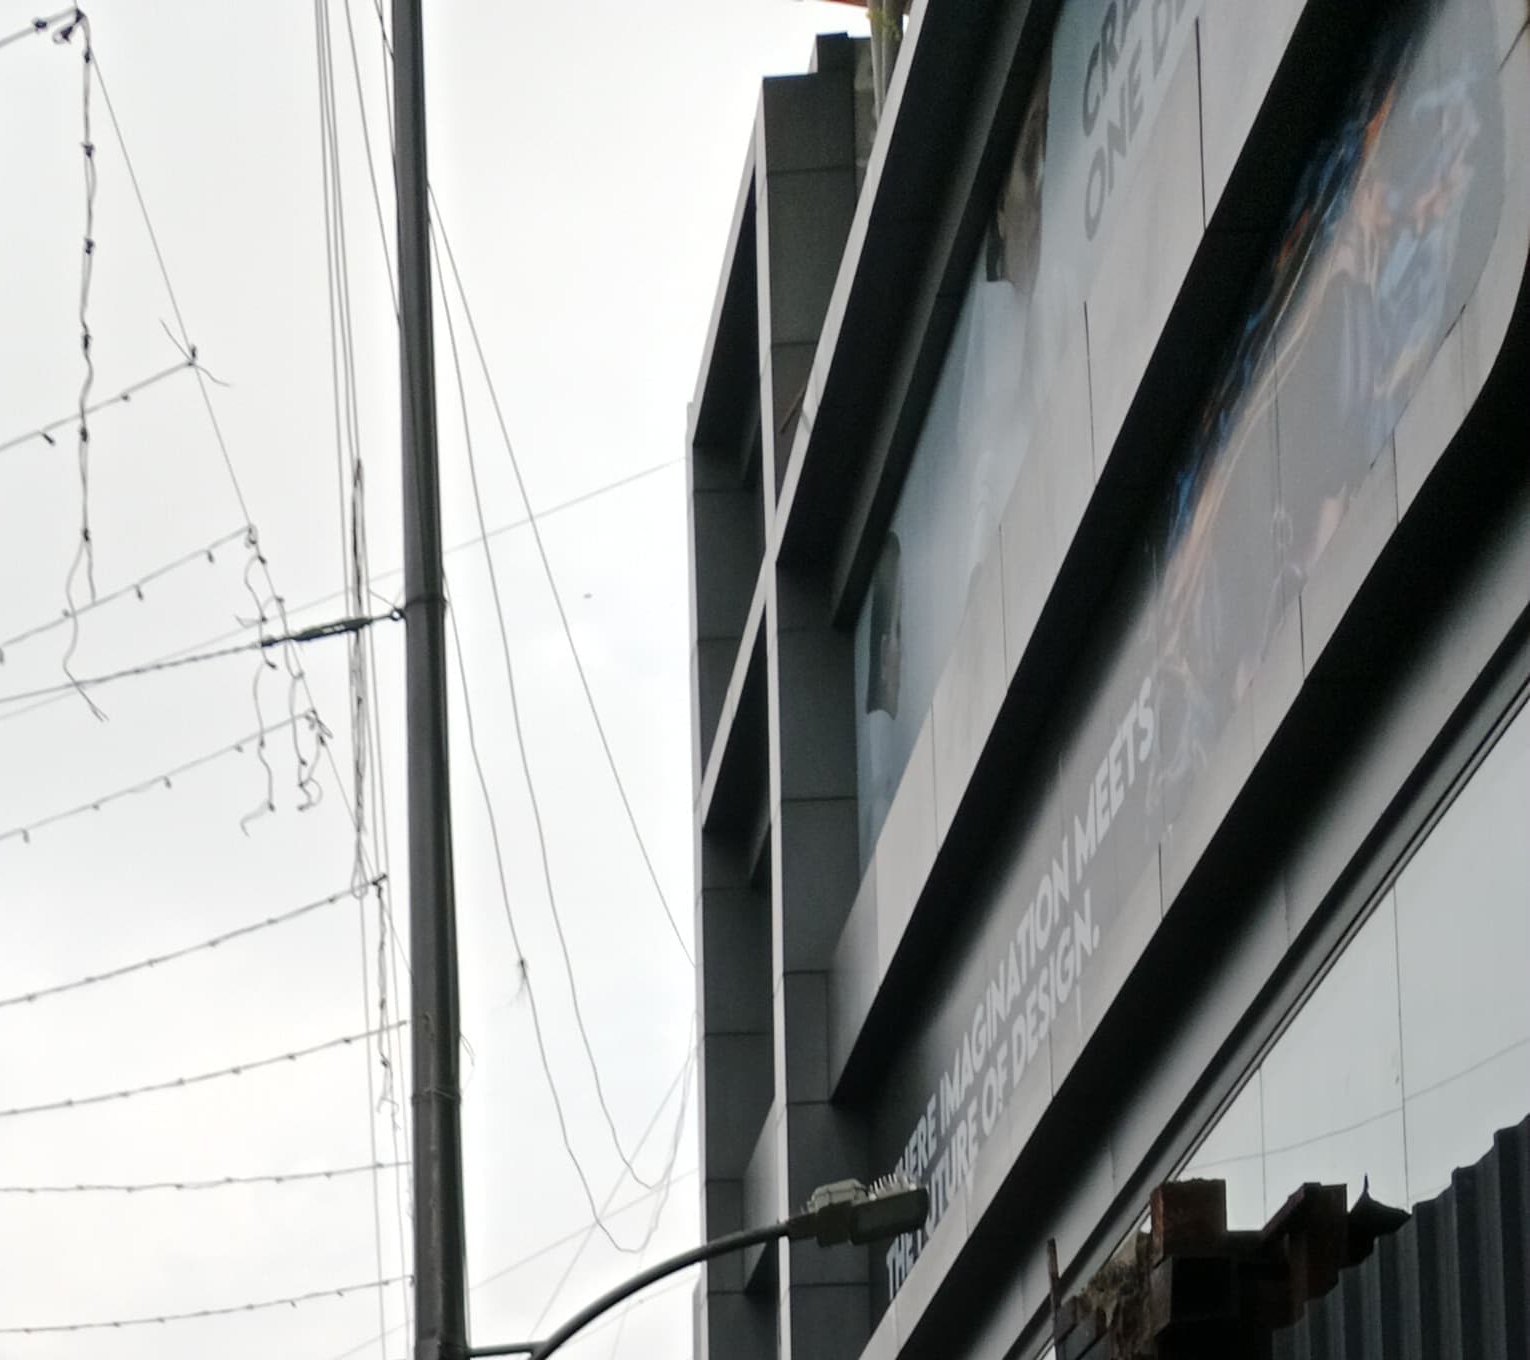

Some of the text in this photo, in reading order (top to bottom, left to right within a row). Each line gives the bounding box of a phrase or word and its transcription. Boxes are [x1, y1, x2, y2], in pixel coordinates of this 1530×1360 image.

[1085, 39, 1144, 241] ONE
[886, 1231, 914, 1301] THE
[982, 1041, 1007, 1136] OF
[1012, 888, 1100, 1088] DESIGN.
[940, 835, 1069, 1136] IMAGINATION
[1074, 677, 1154, 885] MEETS
